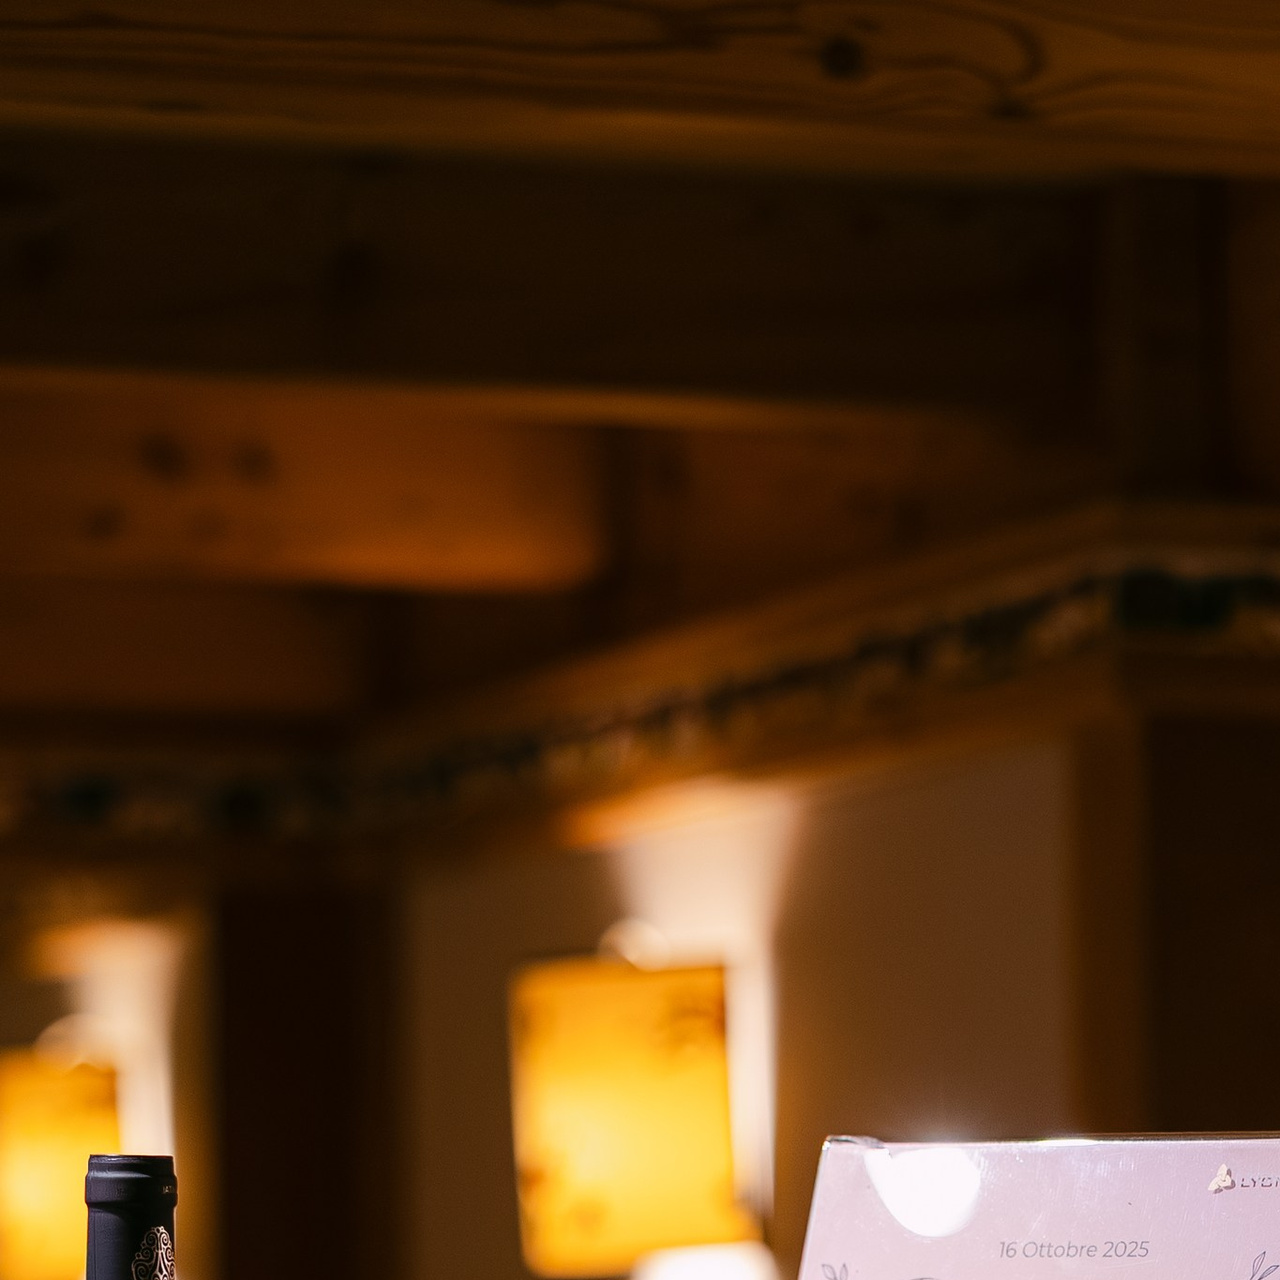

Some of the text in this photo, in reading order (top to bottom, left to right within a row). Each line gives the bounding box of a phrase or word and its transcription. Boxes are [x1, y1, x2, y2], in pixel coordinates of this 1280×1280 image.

[1000, 1241, 1149, 1258] 16 Ottobre 2025
